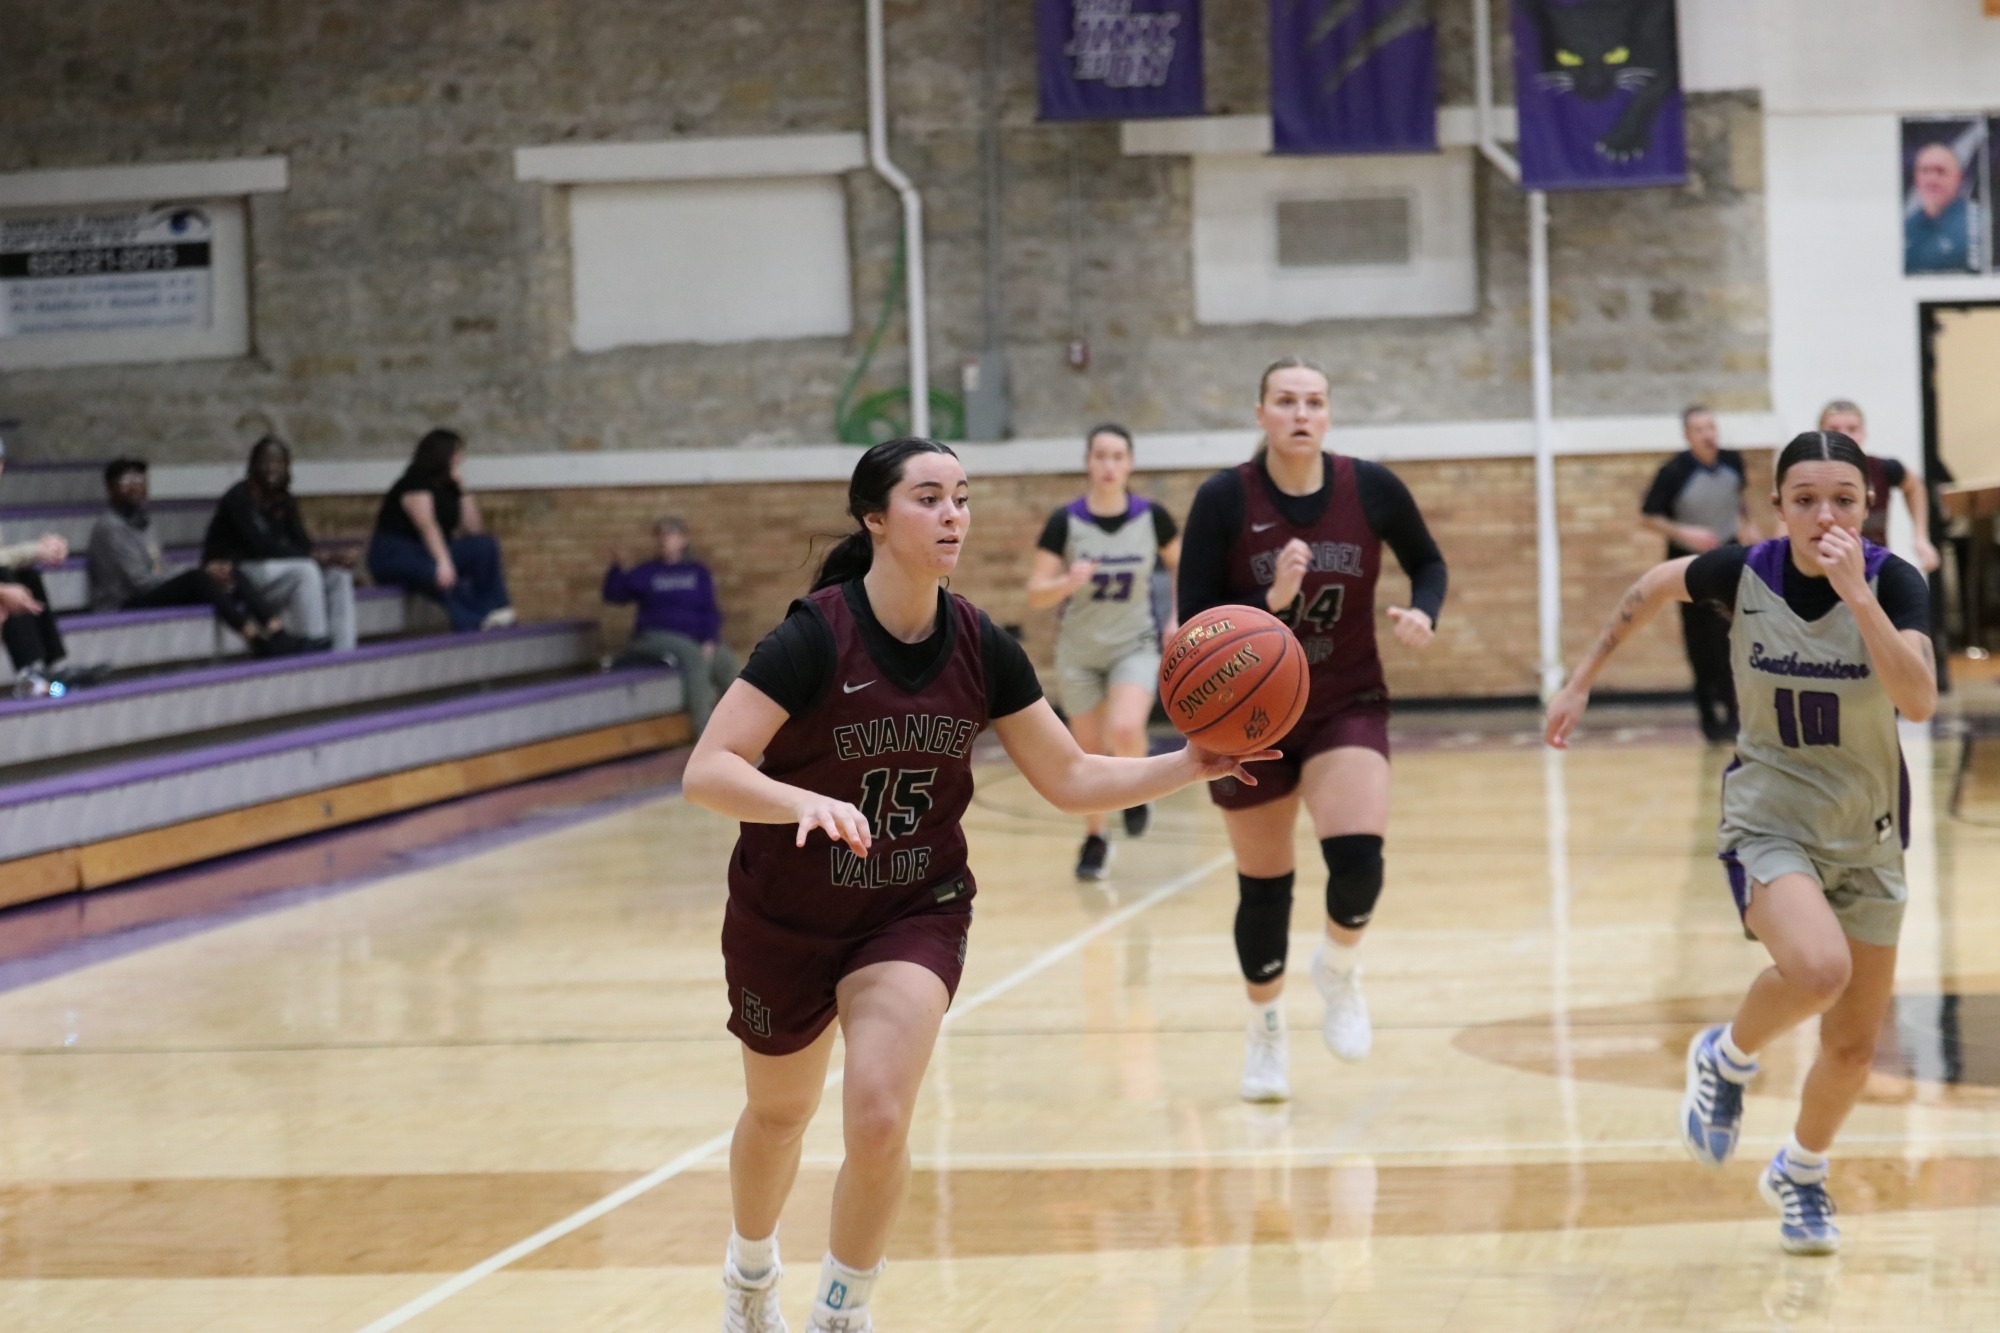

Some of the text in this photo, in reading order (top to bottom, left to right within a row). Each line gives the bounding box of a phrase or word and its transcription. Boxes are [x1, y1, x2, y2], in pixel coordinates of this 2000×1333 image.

[1250, 541, 1363, 585] ENGEL
[1177, 642, 1261, 720] SPALDING
[1775, 686, 1840, 749] 10
[858, 767, 938, 841] 15
[830, 846, 931, 889] VALOR
